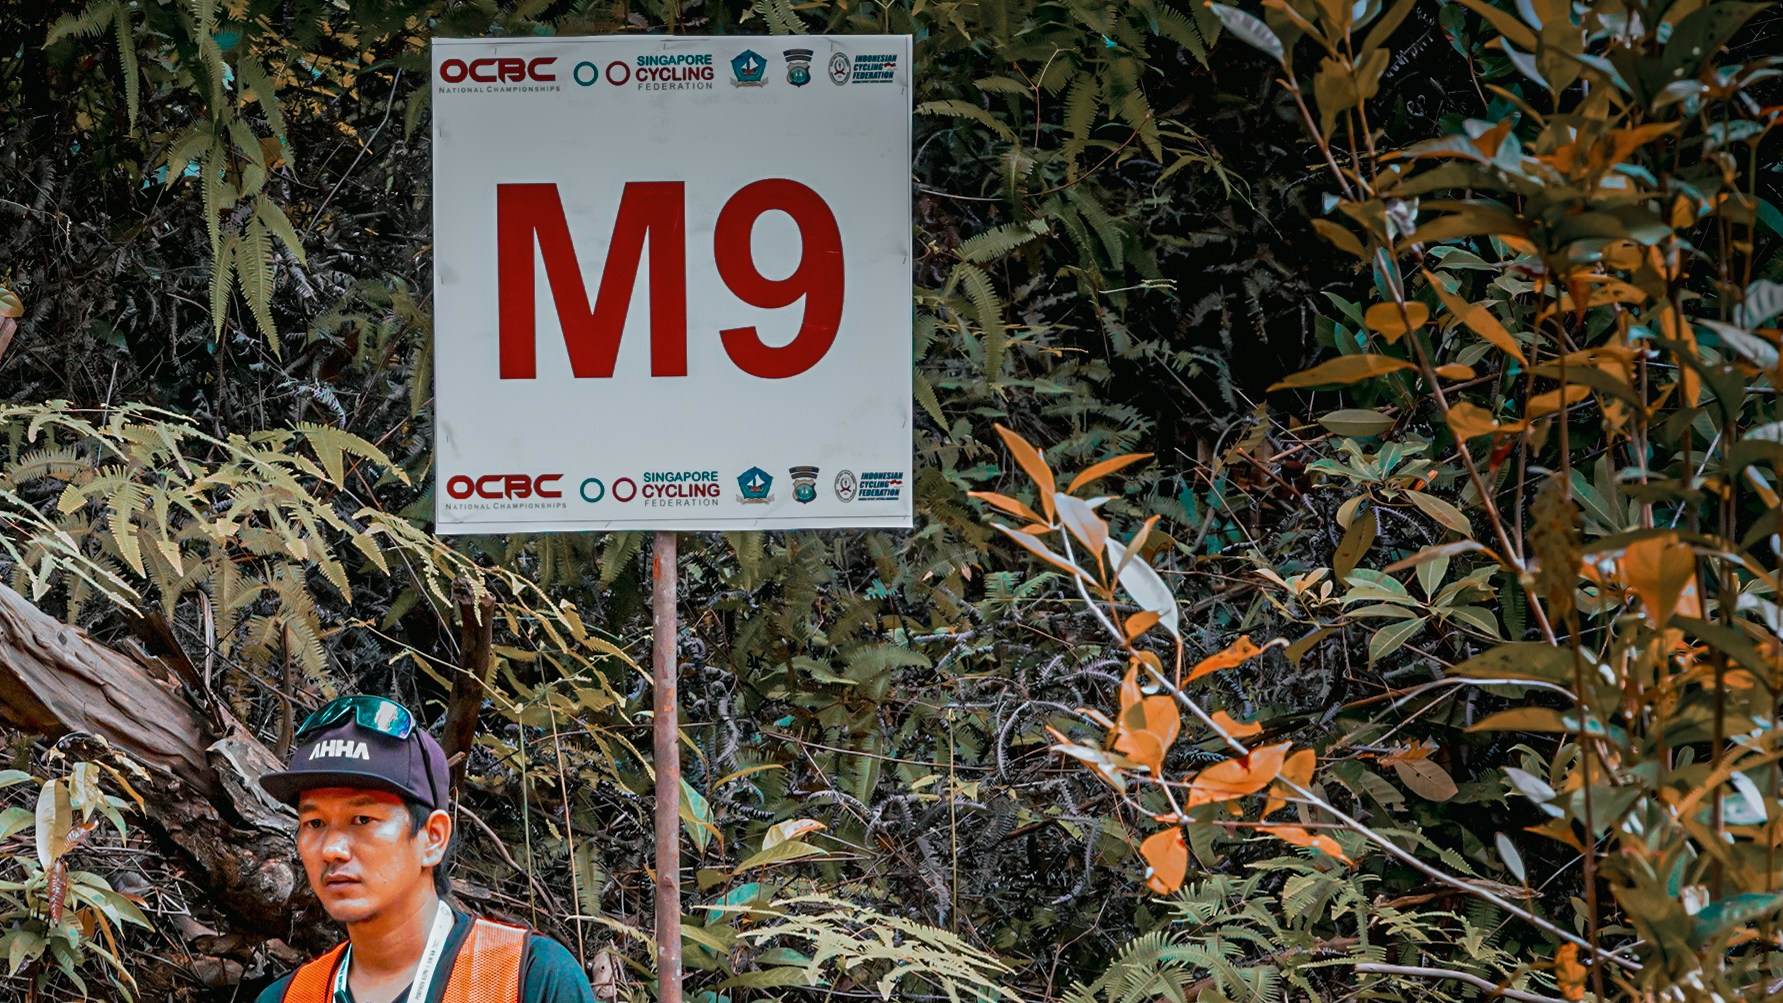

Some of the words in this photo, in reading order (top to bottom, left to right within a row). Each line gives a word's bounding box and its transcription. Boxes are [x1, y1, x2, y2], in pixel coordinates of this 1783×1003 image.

[636, 54, 713, 66] SINGAPORE
[855, 54, 897, 62] INDONESIAN
[439, 56, 559, 85] OCBC
[853, 63, 884, 71] CYCLING
[635, 66, 715, 82] CYCLING
[852, 71, 895, 79] FEDERATION
[637, 81, 713, 91] FEDERATION
[497, 178, 845, 380] M9
[643, 471, 719, 483] SINGAPORE
[860, 472, 903, 480] INDONESIAN
[446, 474, 565, 501] OCBC
[859, 480, 890, 489] CYCLING
[641, 483, 721, 498] CYCLING
[858, 488, 901, 497] FEDERATION
[644, 498, 719, 507] FEDERATION
[309, 739, 370, 761] AHHA
